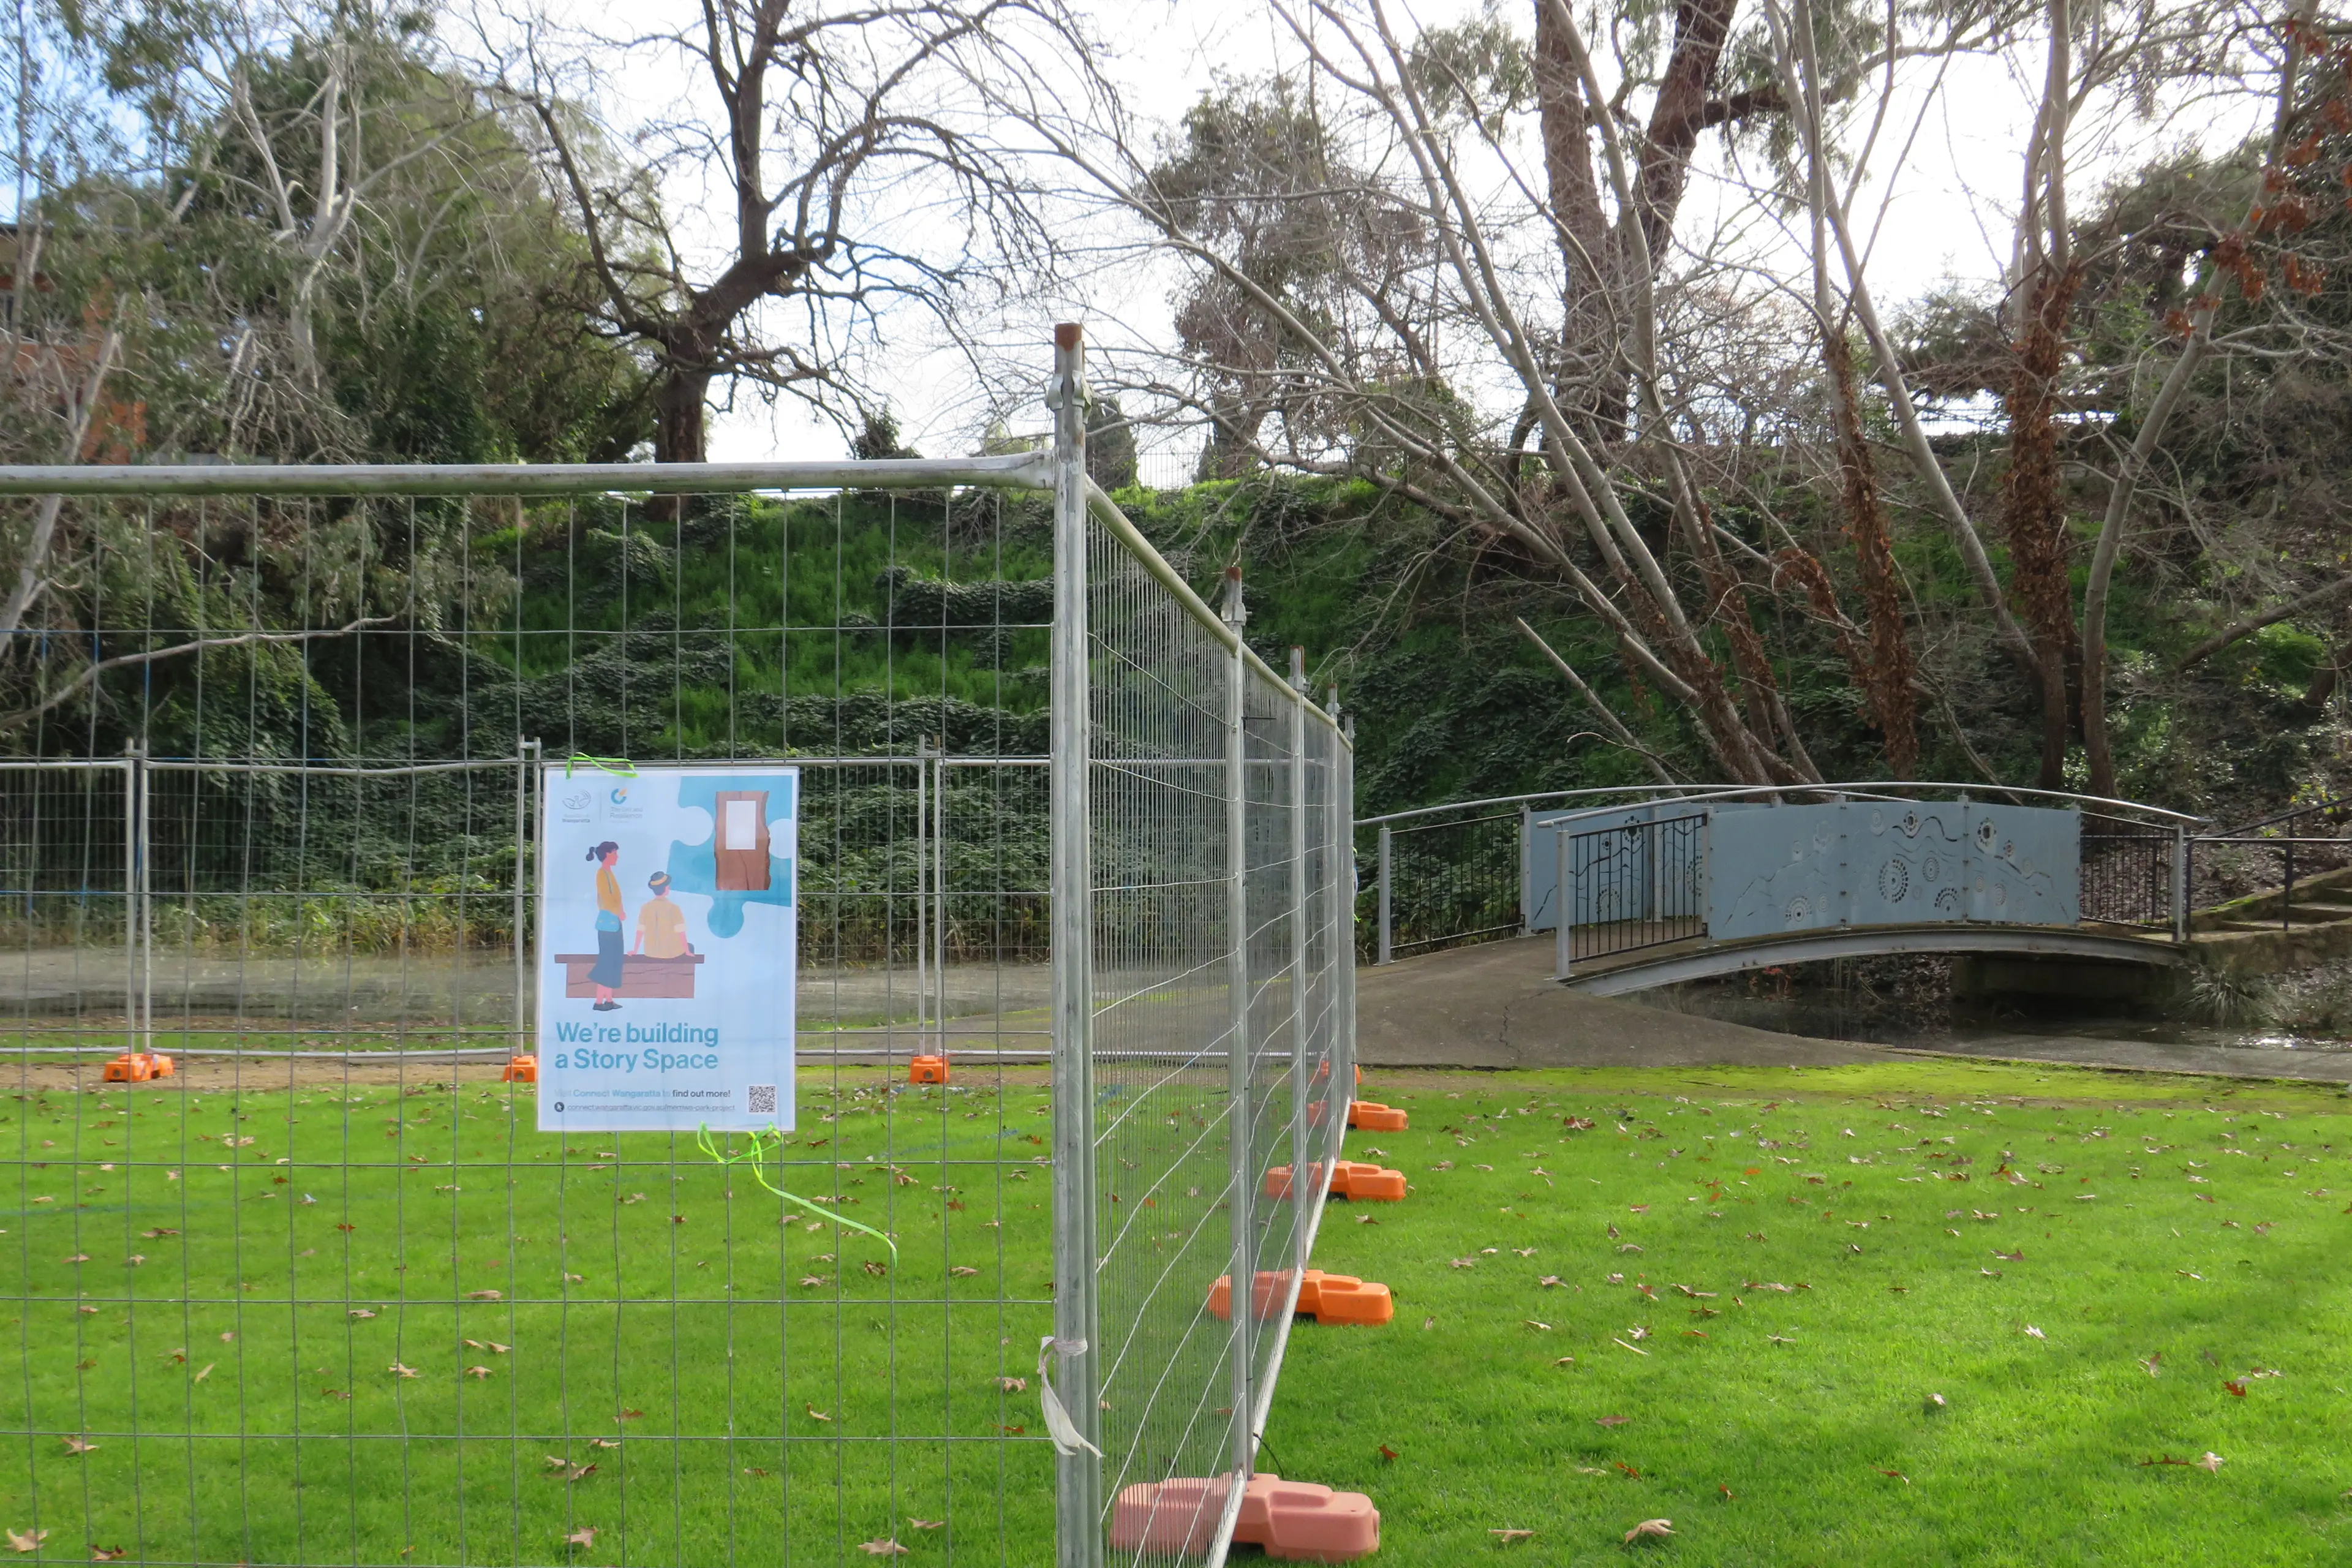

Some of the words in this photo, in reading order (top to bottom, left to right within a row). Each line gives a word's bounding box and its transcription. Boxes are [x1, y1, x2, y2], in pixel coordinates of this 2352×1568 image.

[556, 1022, 621, 1043] We’re
[627, 1022, 719, 1048] building
[555, 1054, 568, 1069] a
[574, 1048, 638, 1073] Story
[643, 1048, 718, 1073] Space
[612, 1089, 661, 1099] Wangaratta
